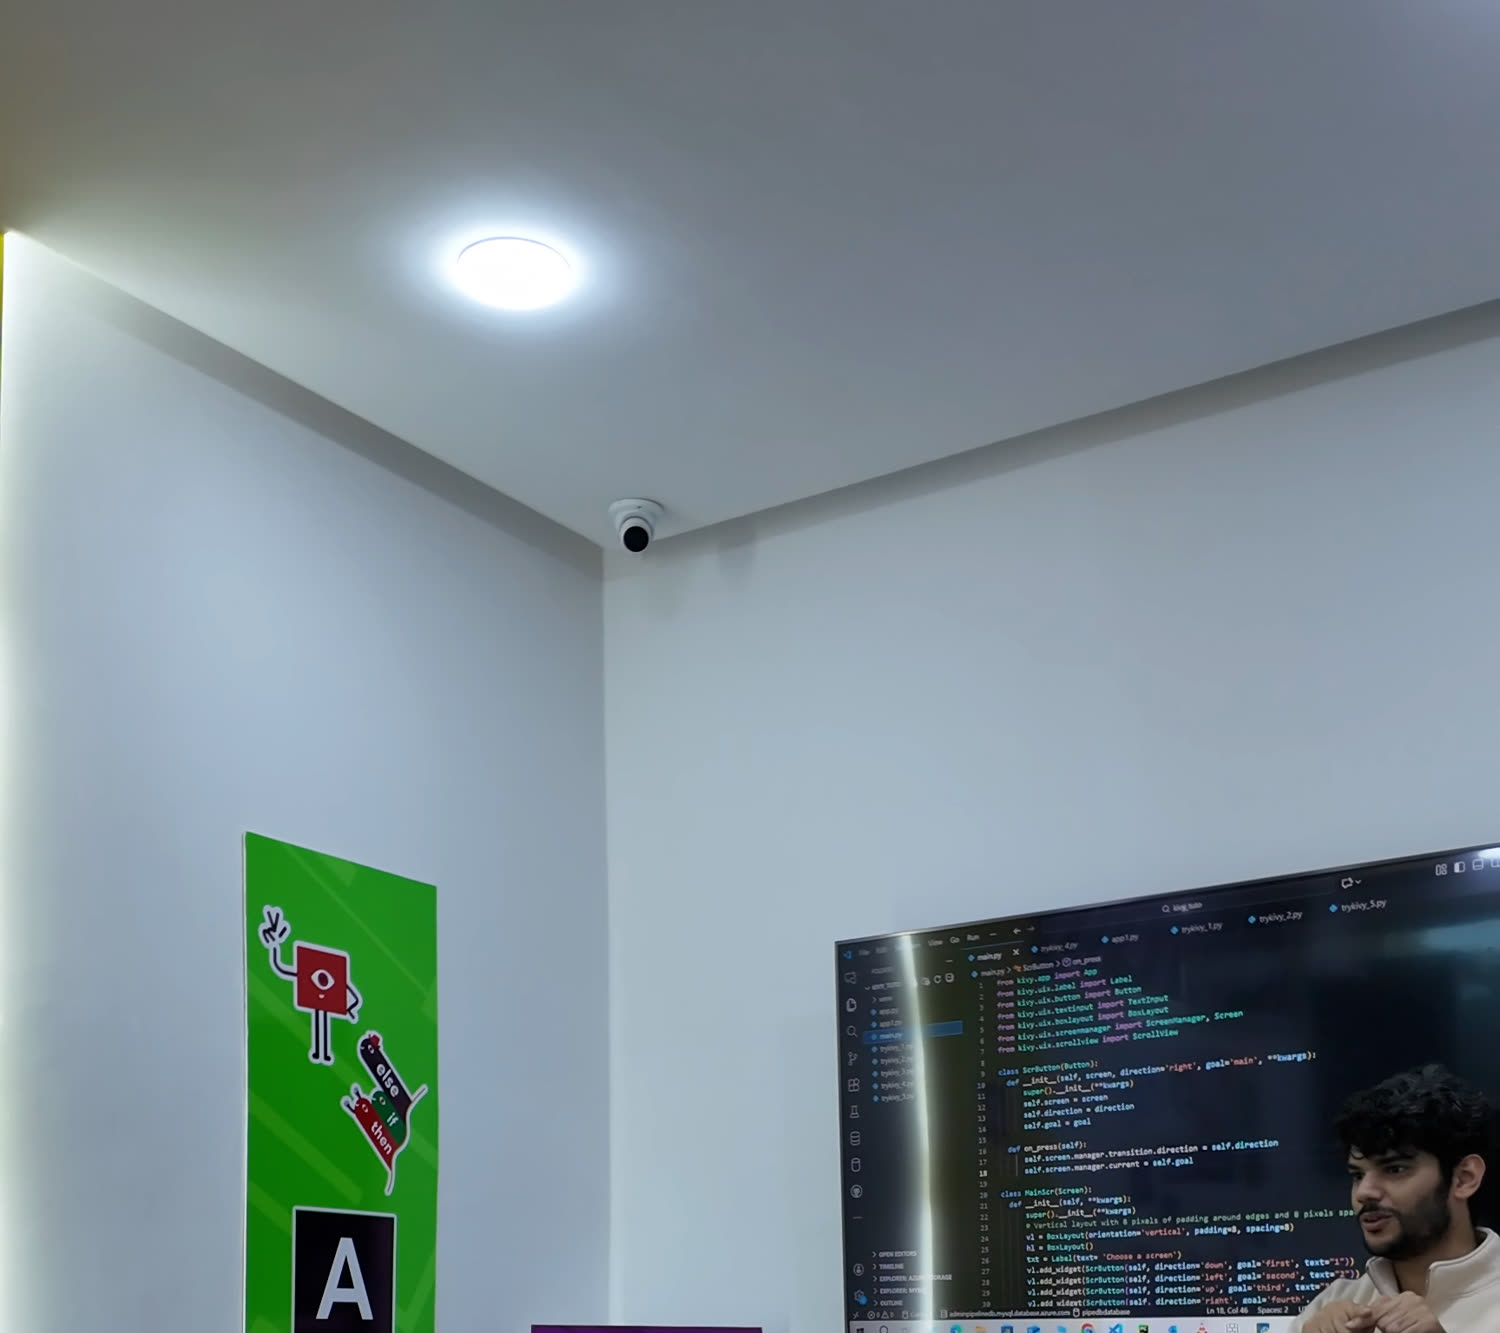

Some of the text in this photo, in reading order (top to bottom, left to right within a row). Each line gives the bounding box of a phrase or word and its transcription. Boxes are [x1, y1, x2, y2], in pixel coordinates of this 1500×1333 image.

[1259, 911, 1303, 923] trykivy_2.py
[1017, 975, 1051, 984] kivy.app
[1054, 971, 1080, 979] import
[1017, 983, 1076, 995] kivy.uix.label
[1080, 979, 1106, 988] import
[1110, 975, 1132, 984] Label
[1017, 993, 1080, 1007] kivy.uix.button
[1085, 990, 1111, 999] import
[1115, 986, 1142, 995] Button
[1017, 1004, 1093, 1018] kivy.uix.textinput
[1097, 1000, 1124, 1009] import
[1128, 995, 1168, 1005] TextInput
[1018, 1015, 1093, 1029] kivy.uix.boxlayout
[1098, 1012, 1124, 1020] import
[1128, 1007, 1168, 1017] BoxLayout
[1018, 1025, 1111, 1040] kivy.uix.screenmanager
[1115, 1021, 1142, 1030] import
[1146, 1014, 1210, 1027] ScreenManager,
[1214, 1010, 1243, 1020] Screen
[1018, 1038, 1099, 1052] kivy.uix.scrollview
[1103, 1034, 1129, 1043] import
[1132, 1029, 1178, 1040] ScrollView
[1023, 1060, 1098, 1074] ScrButton(Button):
[1023, 1074, 1081, 1086] __init__(self,
[1085, 1071, 1116, 1079] screen,
[1120, 1062, 1201, 1076] direction='right',
[1205, 1057, 1262, 1070] goal='main',
[376, 1064, 399, 1097] else
[1024, 1094, 1108, 1108] self.screen screen
[1024, 1103, 1135, 1119] self.direction direction
[387, 1113, 398, 1126] if
[1024, 1118, 1091, 1130] self.goal goal
[371, 1122, 392, 1154] then
[1024, 1142, 1086, 1153] on_press(self):
[1024, 1139, 1279, 1163] self.screen.manager.transition.direction self.direction
[1025, 1161, 1139, 1175] self.screen.manager.current
[1153, 1157, 1193, 1167] self.goal
[1025, 1187, 1092, 1197] MainScr(Screen):
[1025, 1197, 1083, 1209] __init__(self,
[1132, 1217, 1158, 1226] pixels
[1163, 1216, 1172, 1224] of
[1176, 1215, 1209, 1224] padding
[1213, 1213, 1241, 1222] around
[1246, 1213, 1270, 1221] edges
[1275, 1211, 1289, 1219] and
[1304, 1209, 1333, 1218] pixels
[1339, 1209, 1356, 1217] spa
[1194, 1224, 1241, 1236] padding=8,
[1246, 1223, 1294, 1233] spacing=8)
[1047, 1242, 1093, 1252] BoxLayout()
[1052, 1254, 1098, 1263] Label(text=
[1103, 1253, 1132, 1261] 'Choose
[1146, 1251, 1182, 1260] screen')
[1027, 1264, 1150, 1275] vl.add_widget(ScrButton(self,
[1154, 1261, 1232, 1270] direction='down',
[1237, 1259, 1299, 1270] goal='first',
[316, 1237, 373, 1320] A
[1027, 1275, 1150, 1286] vl.add_widget(ScrButton(self,
[1155, 1272, 1233, 1283] direction='left',
[1237, 1270, 1304, 1282] goal='second',
[1028, 1286, 1150, 1297] vl.add_widget(ScrButton(self,
[1155, 1284, 1223, 1294] direction='up',
[1228, 1282, 1290, 1294] goal='third',
[1258, 1306, 1282, 1314] Spaces:
